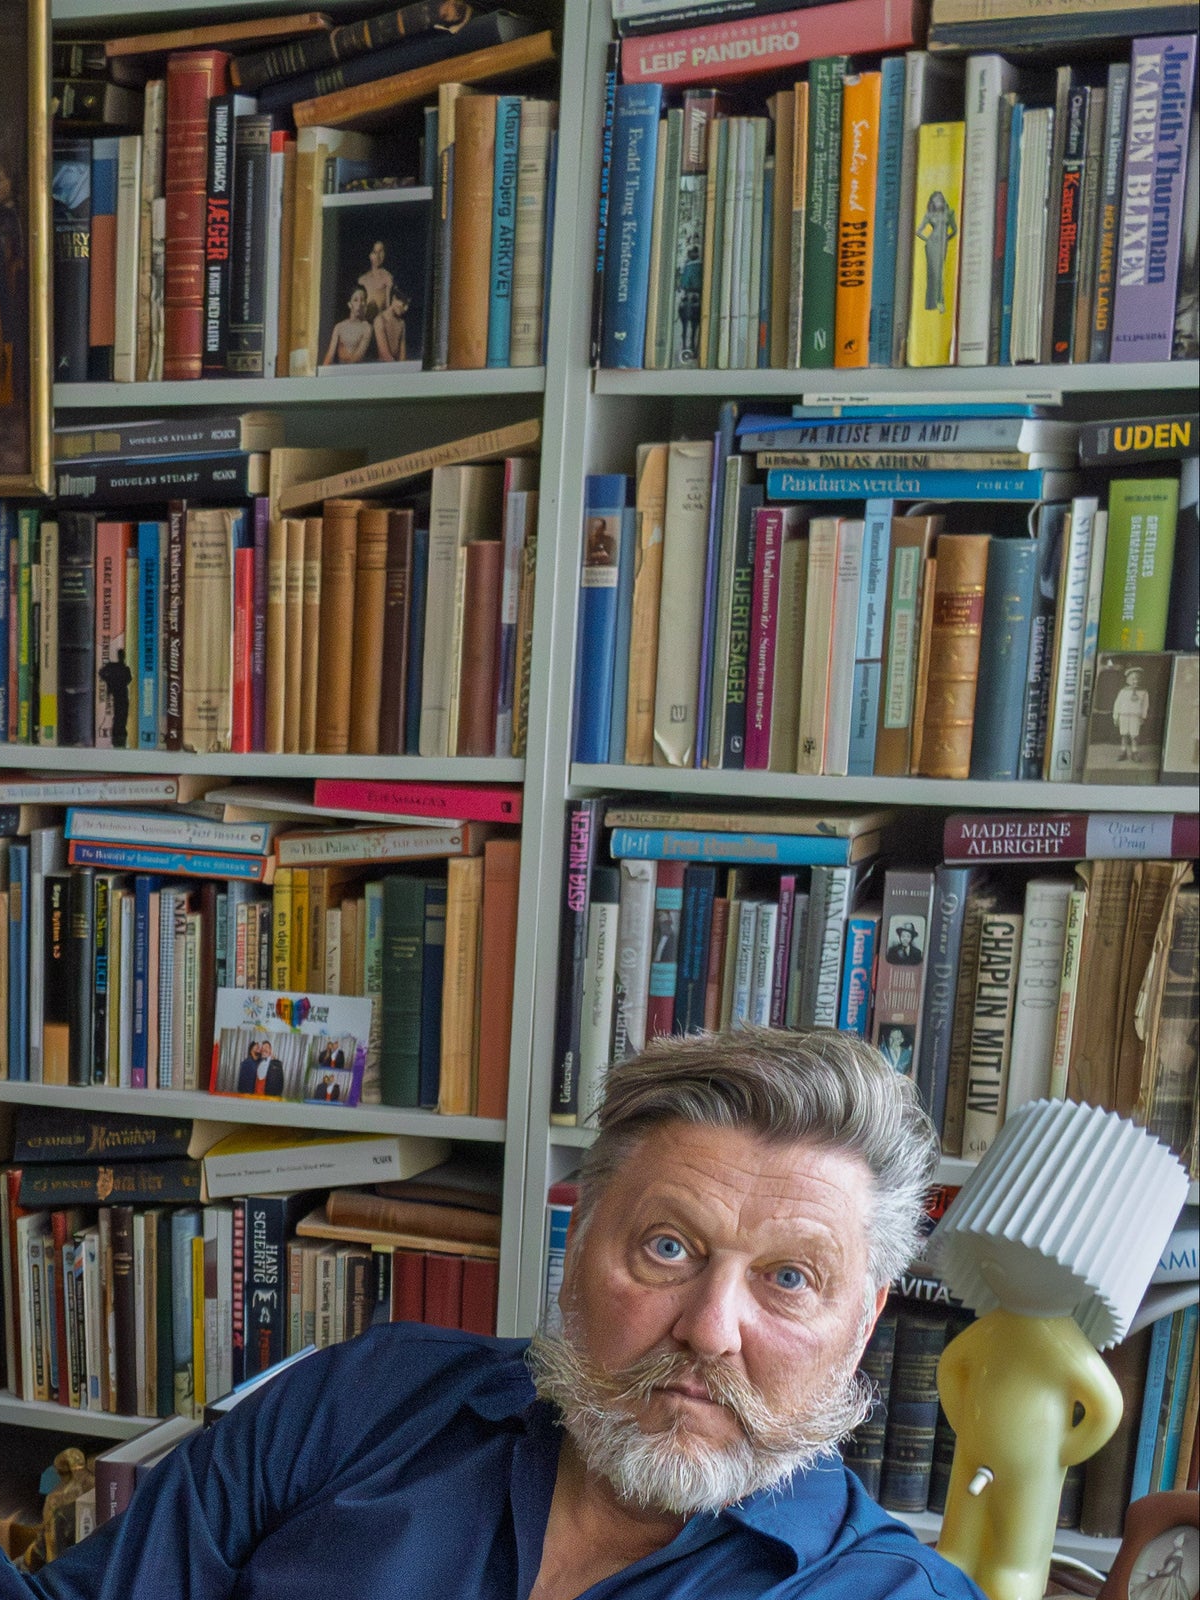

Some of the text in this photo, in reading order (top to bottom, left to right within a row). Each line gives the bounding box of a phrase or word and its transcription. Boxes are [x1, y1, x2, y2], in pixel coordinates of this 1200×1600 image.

[640, 31, 800, 76] LEIF PANDURO
[213, 105, 228, 193] THOMAS RATHSACK
[503, 102, 520, 149] Klaus
[497, 152, 518, 217] Rifbjerg
[1118, 53, 1161, 288] KAREN BLIXEN
[1147, 44, 1188, 284] Judith Thurman
[617, 128, 643, 303] Evald Tang Kristensen
[849, 178, 867, 212] med
[1103, 205, 1115, 231] NO
[206, 197, 230, 261] JÆGER
[839, 221, 868, 289] PICASSO
[207, 296, 220, 318] MED
[1095, 287, 1110, 331] LAND
[879, 424, 960, 443] MED AMDI
[1113, 421, 1190, 452] UDEN
[110, 473, 200, 488] DOUGLAS STUART
[781, 473, 921, 492] Panduros verden
[819, 455, 870, 468] PALLAS
[977, 481, 1025, 490] FORUM
[765, 518, 777, 545] Finn
[1141, 515, 1159, 578] GRETELISES
[1067, 517, 1091, 633] SYLVIA PIO
[1121, 516, 1143, 622] DANMARKSHISTORIE
[726, 568, 750, 704] HJERTESAGER
[1022, 616, 1045, 760] DENGANG LEMVIG
[960, 821, 1071, 838] MADELEINE
[967, 839, 1063, 856] ALBRIGHT
[568, 811, 590, 913] ASTA NIELSEN
[278, 912, 287, 927] en
[824, 875, 847, 922] JOAN
[846, 926, 871, 1025] Joan Collins
[974, 920, 1016, 1020] CHAPLIN
[1021, 917, 1064, 1010] GARBO
[971, 1027, 1004, 1073] MIT
[967, 1078, 1000, 1116] LIV
[253, 1211, 266, 1284] SCHERFIG
[265, 1244, 278, 1284] HANS
